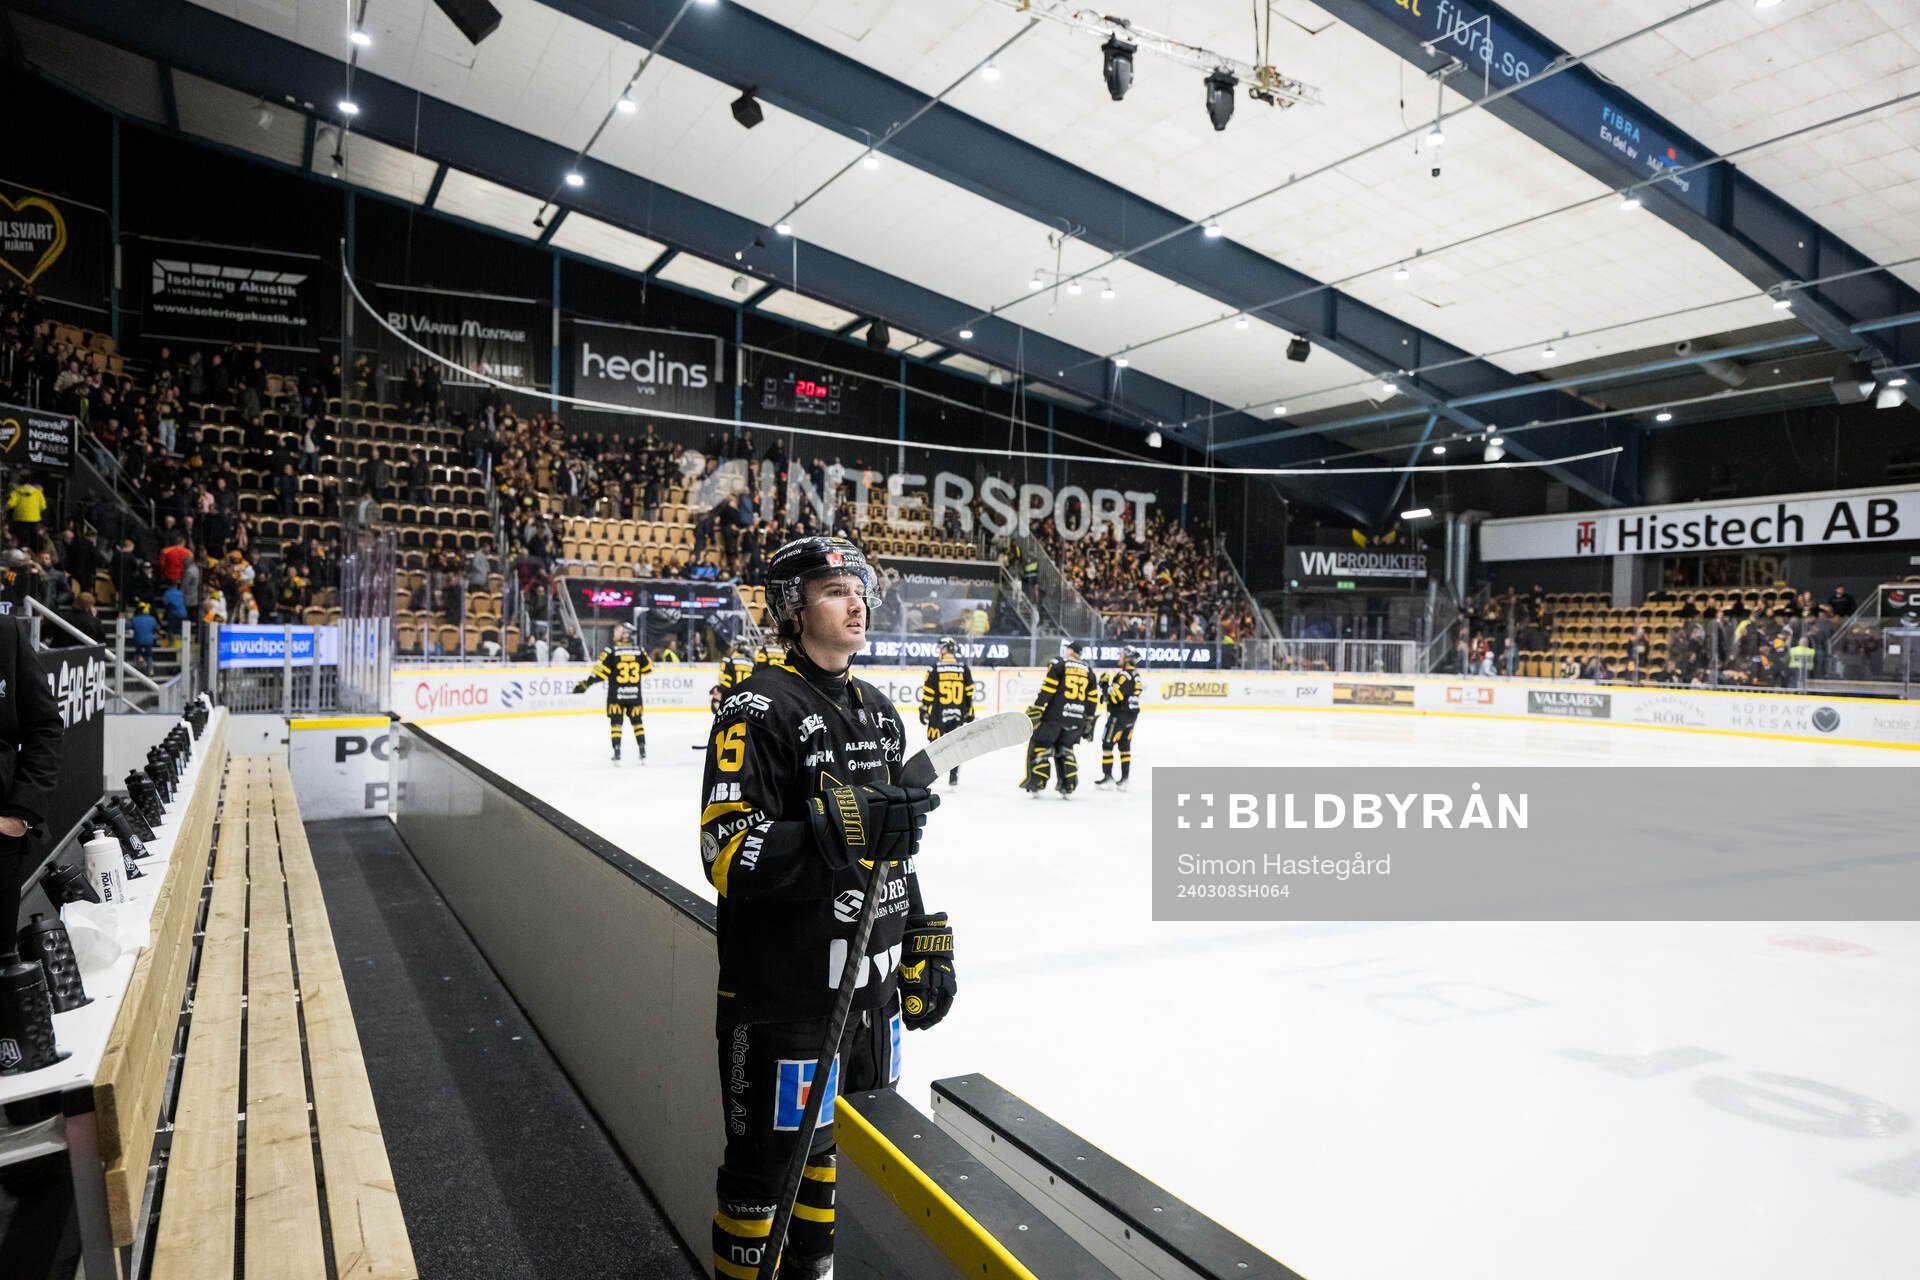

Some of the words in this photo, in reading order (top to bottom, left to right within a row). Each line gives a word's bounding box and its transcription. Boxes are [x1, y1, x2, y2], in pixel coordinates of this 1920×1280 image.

[1436, 0, 1530, 83] fibra.se
[1600, 125, 1612, 143] En
[1602, 106, 1640, 142] FIBRA
[167, 272, 236, 293] Isolering
[239, 281, 297, 297] Akustik
[153, 303, 308, 326] www.isoleringakustik.se
[583, 342, 708, 388] hedins
[28, 428, 69, 444] Nordea
[760, 456, 1157, 545] INTERSPORT
[1618, 504, 1804, 552] Hisstech
[1822, 498, 1901, 541] AB
[1300, 551, 1337, 576] VM
[1337, 553, 1427, 570] PRODUKTER
[903, 573, 947, 585] Vidman
[221, 637, 311, 656] uvudsposor
[986, 645, 1009, 659] AB
[1191, 649, 1211, 662] AB
[616, 661, 640, 683] 33
[415, 681, 488, 712] Cylinda
[528, 676, 575, 696] SÖRB
[938, 680, 964, 705] 50
[1064, 674, 1089, 701] 53
[1162, 682, 1187, 700] JB
[1188, 682, 1228, 694] SMIDE
[1731, 702, 1806, 715] KOPPAR
[715, 721, 747, 772] 15
[740, 835, 764, 871] JAN
